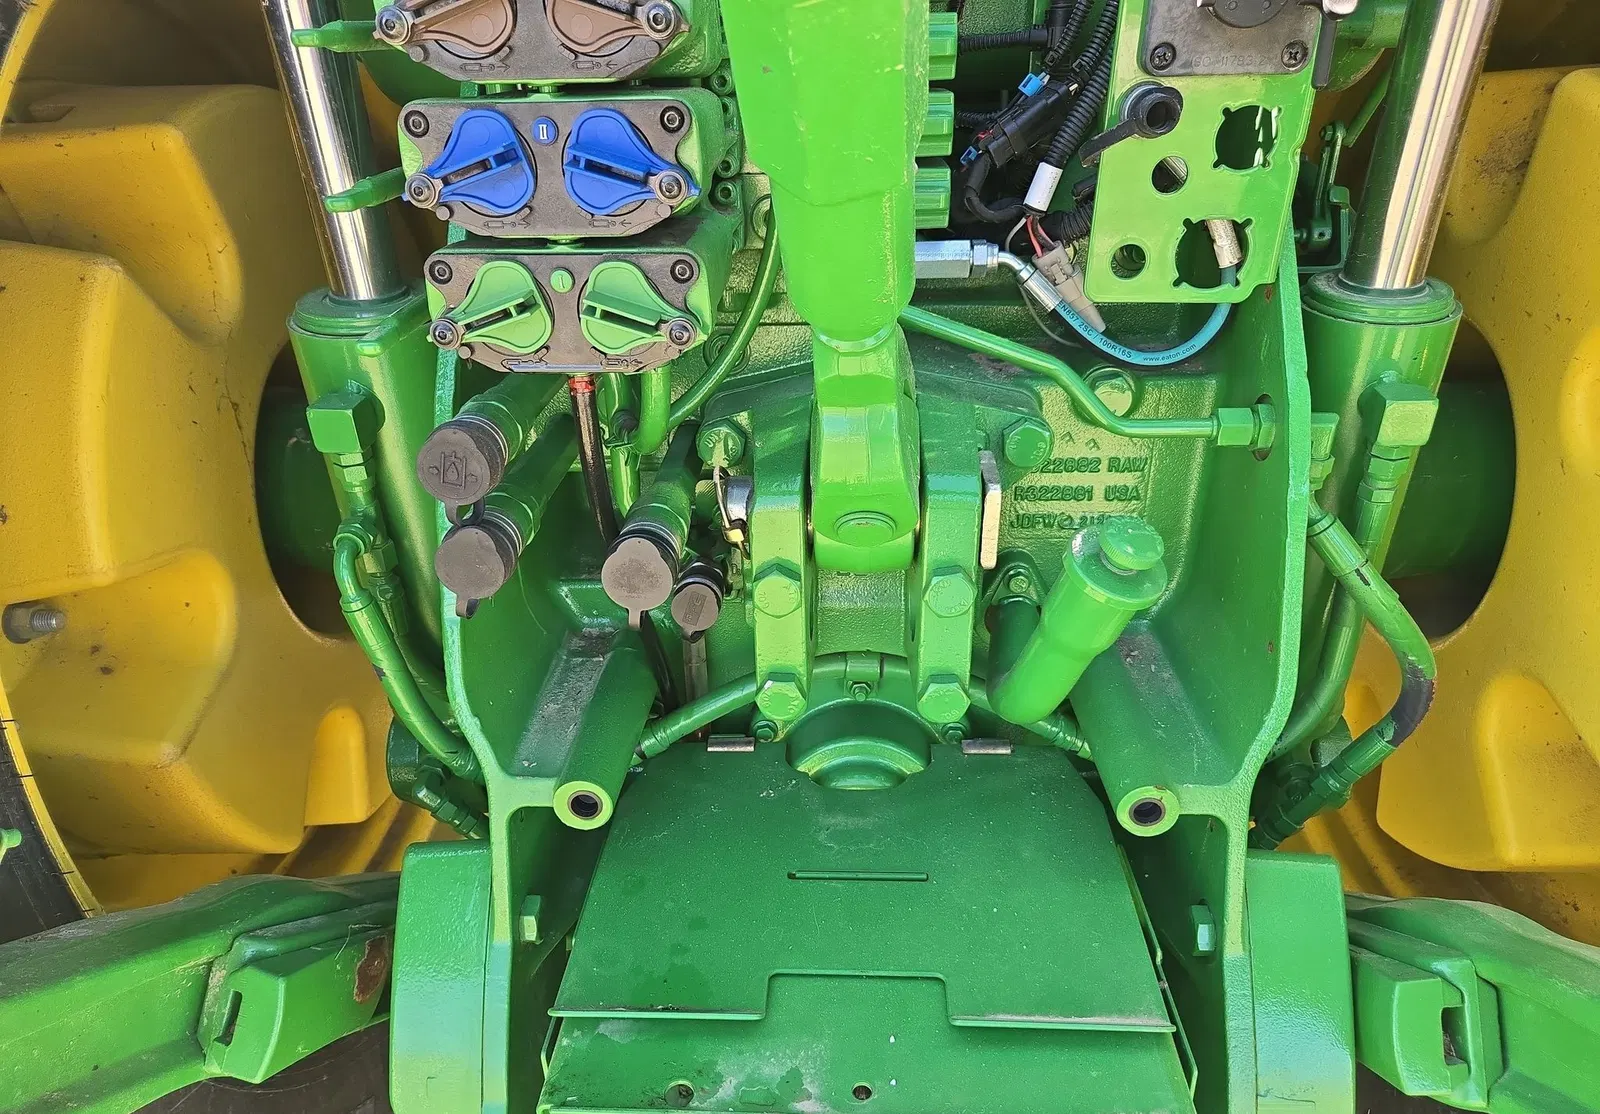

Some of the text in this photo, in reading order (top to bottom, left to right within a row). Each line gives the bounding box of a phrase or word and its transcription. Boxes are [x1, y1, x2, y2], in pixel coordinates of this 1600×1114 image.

[1058, 301, 1079, 323] EN857
[1078, 319, 1093, 336] 2SC
[1099, 337, 1133, 359] 100R16S
[1143, 344, 1196, 361] www.eaton.com
[1032, 456, 1148, 473] 22882 RAW
[1013, 484, 1142, 502] R322881 USA
[1010, 512, 1058, 530] JDFW
